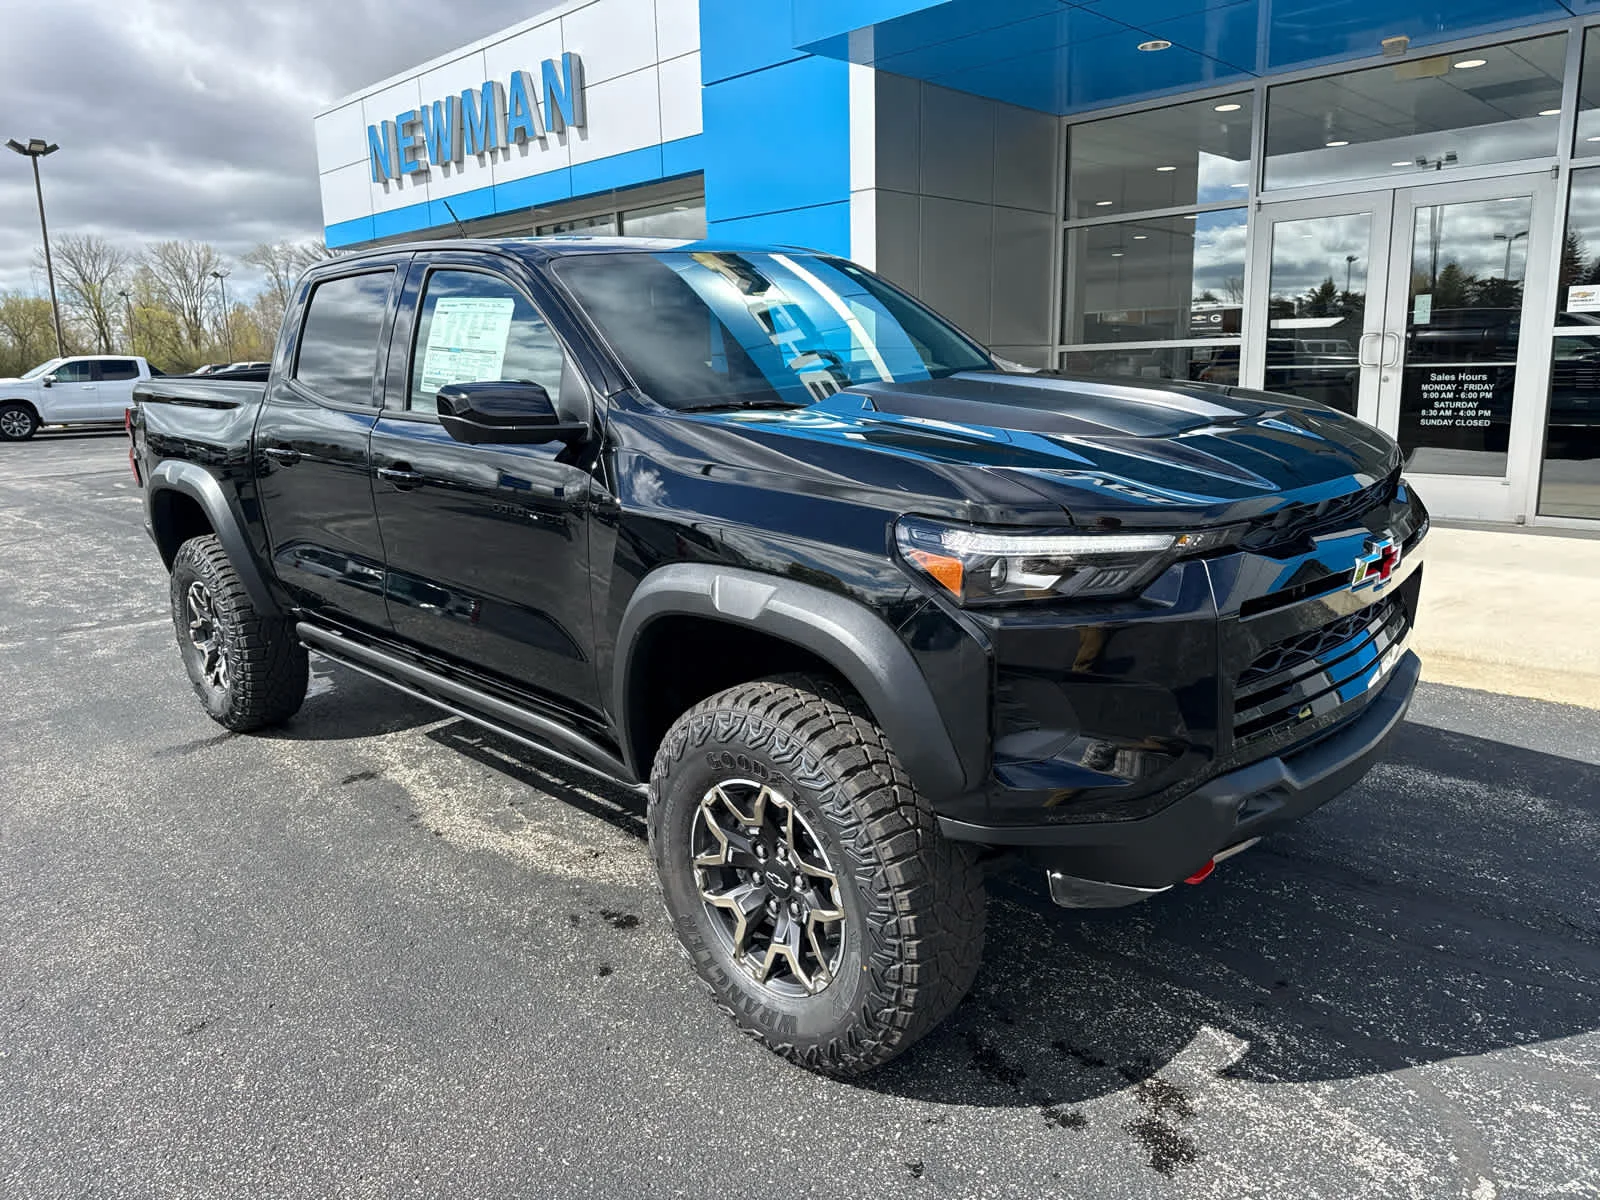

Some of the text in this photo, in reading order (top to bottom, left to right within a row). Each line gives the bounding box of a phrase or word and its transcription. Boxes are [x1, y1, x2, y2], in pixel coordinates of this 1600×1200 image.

[367, 52, 582, 184] NEWMAN
[1430, 373, 1488, 381] Sales Hours
[1463, 383, 1495, 391] FRIDAY
